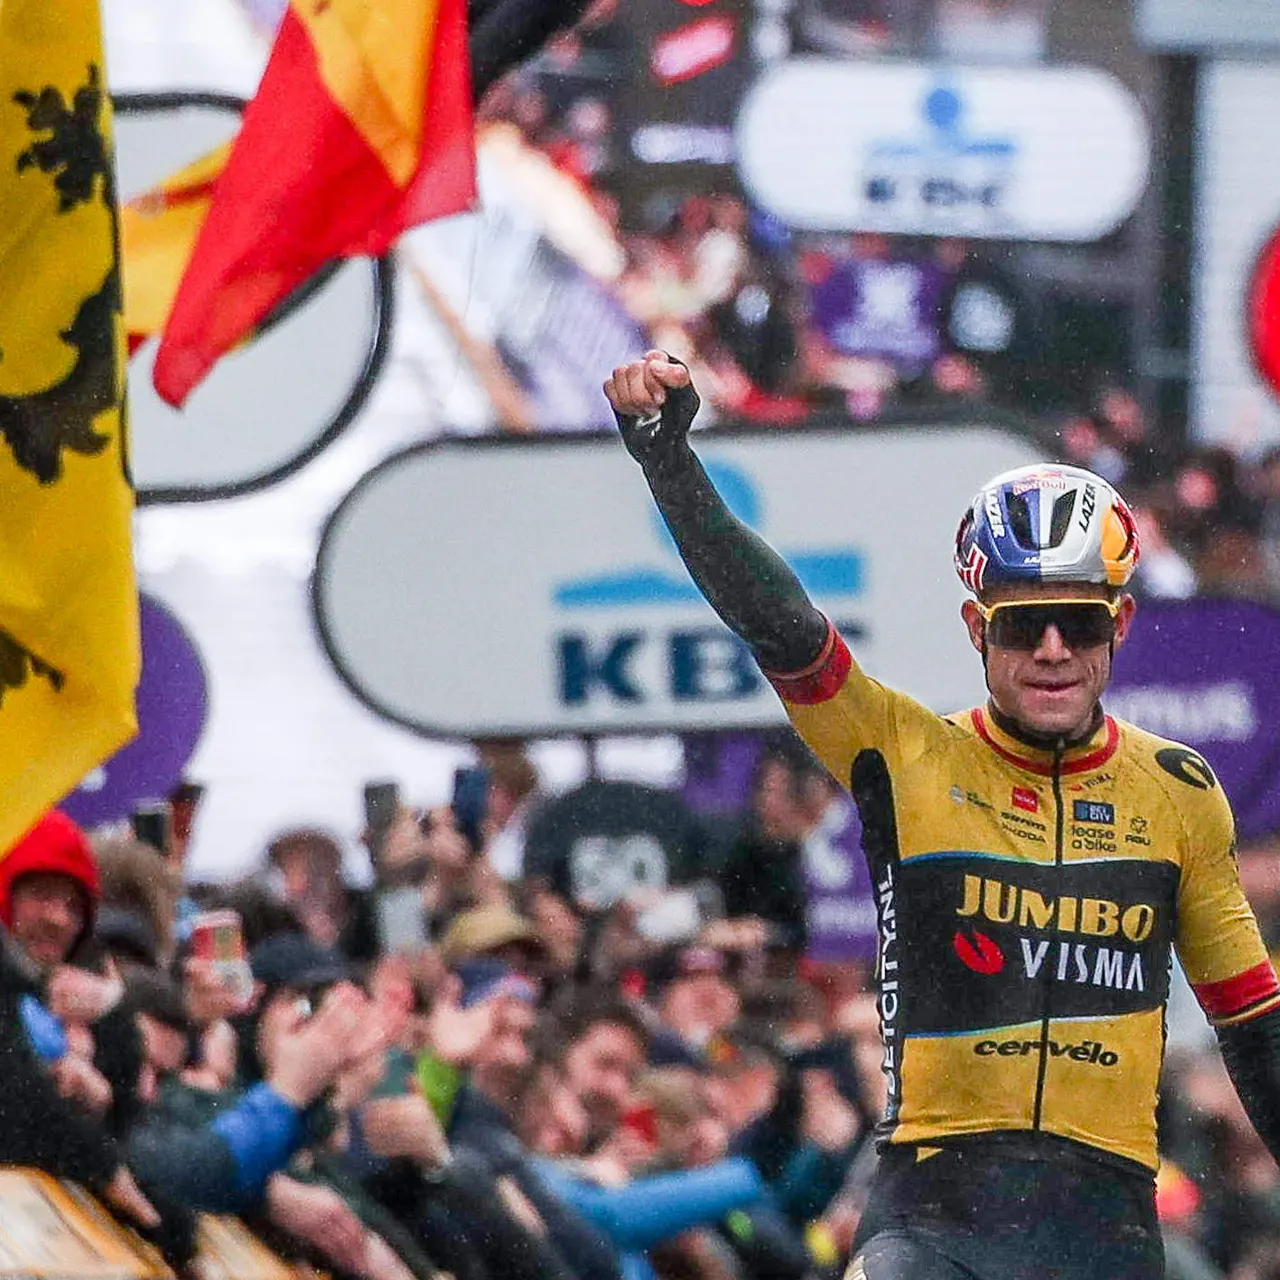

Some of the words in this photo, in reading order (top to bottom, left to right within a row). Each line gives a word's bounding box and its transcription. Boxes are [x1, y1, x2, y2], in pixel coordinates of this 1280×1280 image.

[1078, 483, 1097, 534] LAZER
[556, 624, 868, 706] KB
[1071, 824, 1115, 840] lease
[1125, 834, 1151, 846] AGU
[955, 873, 1155, 943] JUMBO
[1019, 937, 1144, 992] VISMA
[973, 1039, 1119, 1067] cervélo
